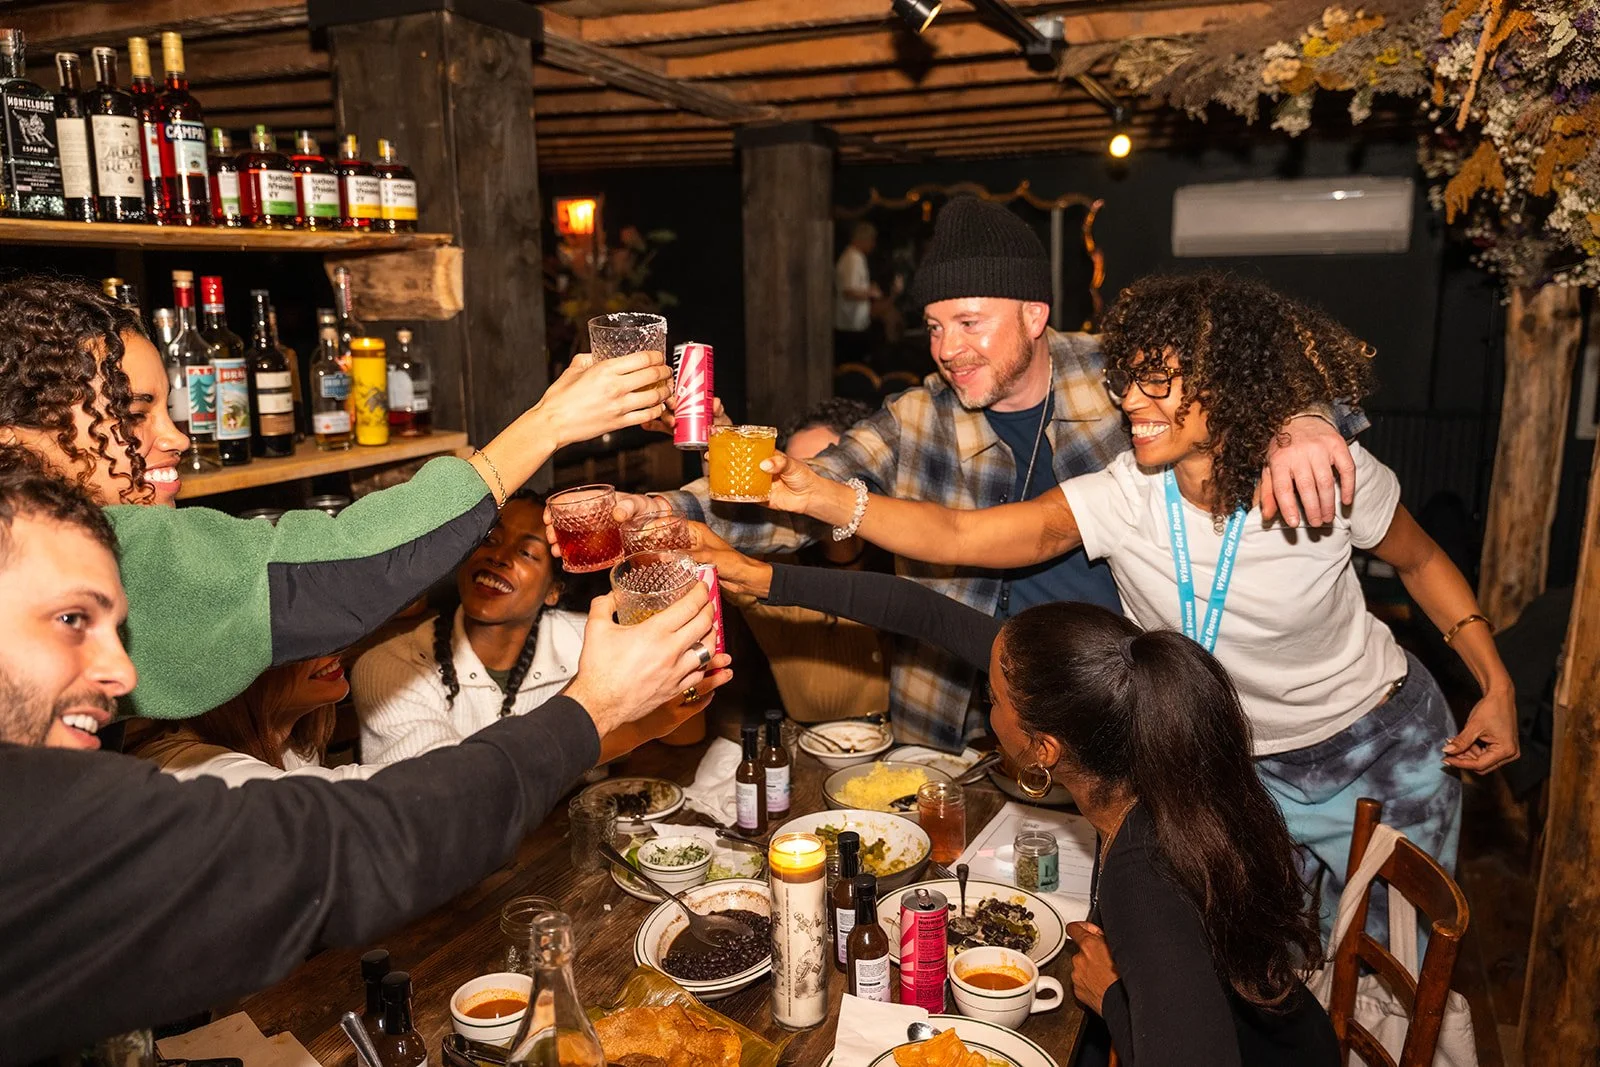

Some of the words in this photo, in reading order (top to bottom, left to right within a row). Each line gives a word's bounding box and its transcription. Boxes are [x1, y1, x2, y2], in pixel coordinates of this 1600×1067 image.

[7, 95, 55, 112] MONTELOBOS
[1171, 502, 1182, 531] Down
[1229, 510, 1243, 541] Down
[1175, 532, 1184, 548] Get
[1224, 540, 1235, 557] Get
[1178, 549, 1189, 584] Winter
[1216, 557, 1231, 591] Winter
[1185, 600, 1193, 628] Down
[1205, 608, 1219, 637] Down
